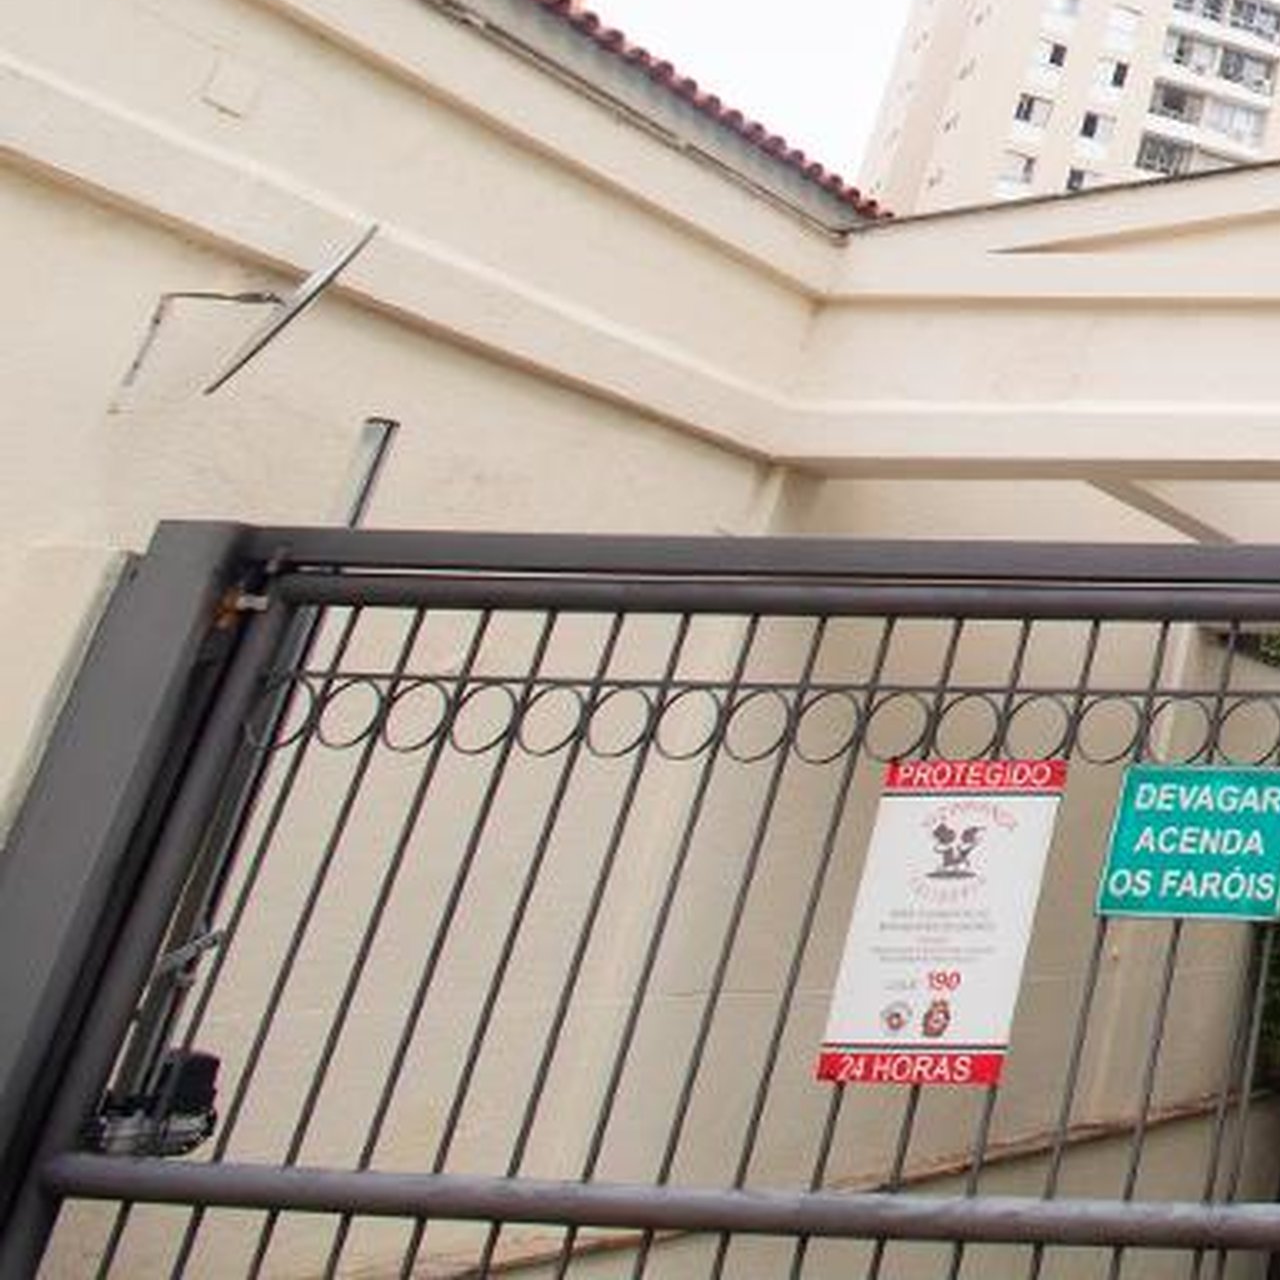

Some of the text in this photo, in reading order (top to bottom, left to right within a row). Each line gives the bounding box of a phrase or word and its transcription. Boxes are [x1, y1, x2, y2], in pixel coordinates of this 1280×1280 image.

[896, 760, 1052, 787] PROTEGIDO
[1133, 825, 1265, 856] ACENDA
[1108, 866, 1276, 901] OS FARÓIS
[927, 970, 962, 992] 190
[836, 1055, 974, 1083] 24 HORAS
